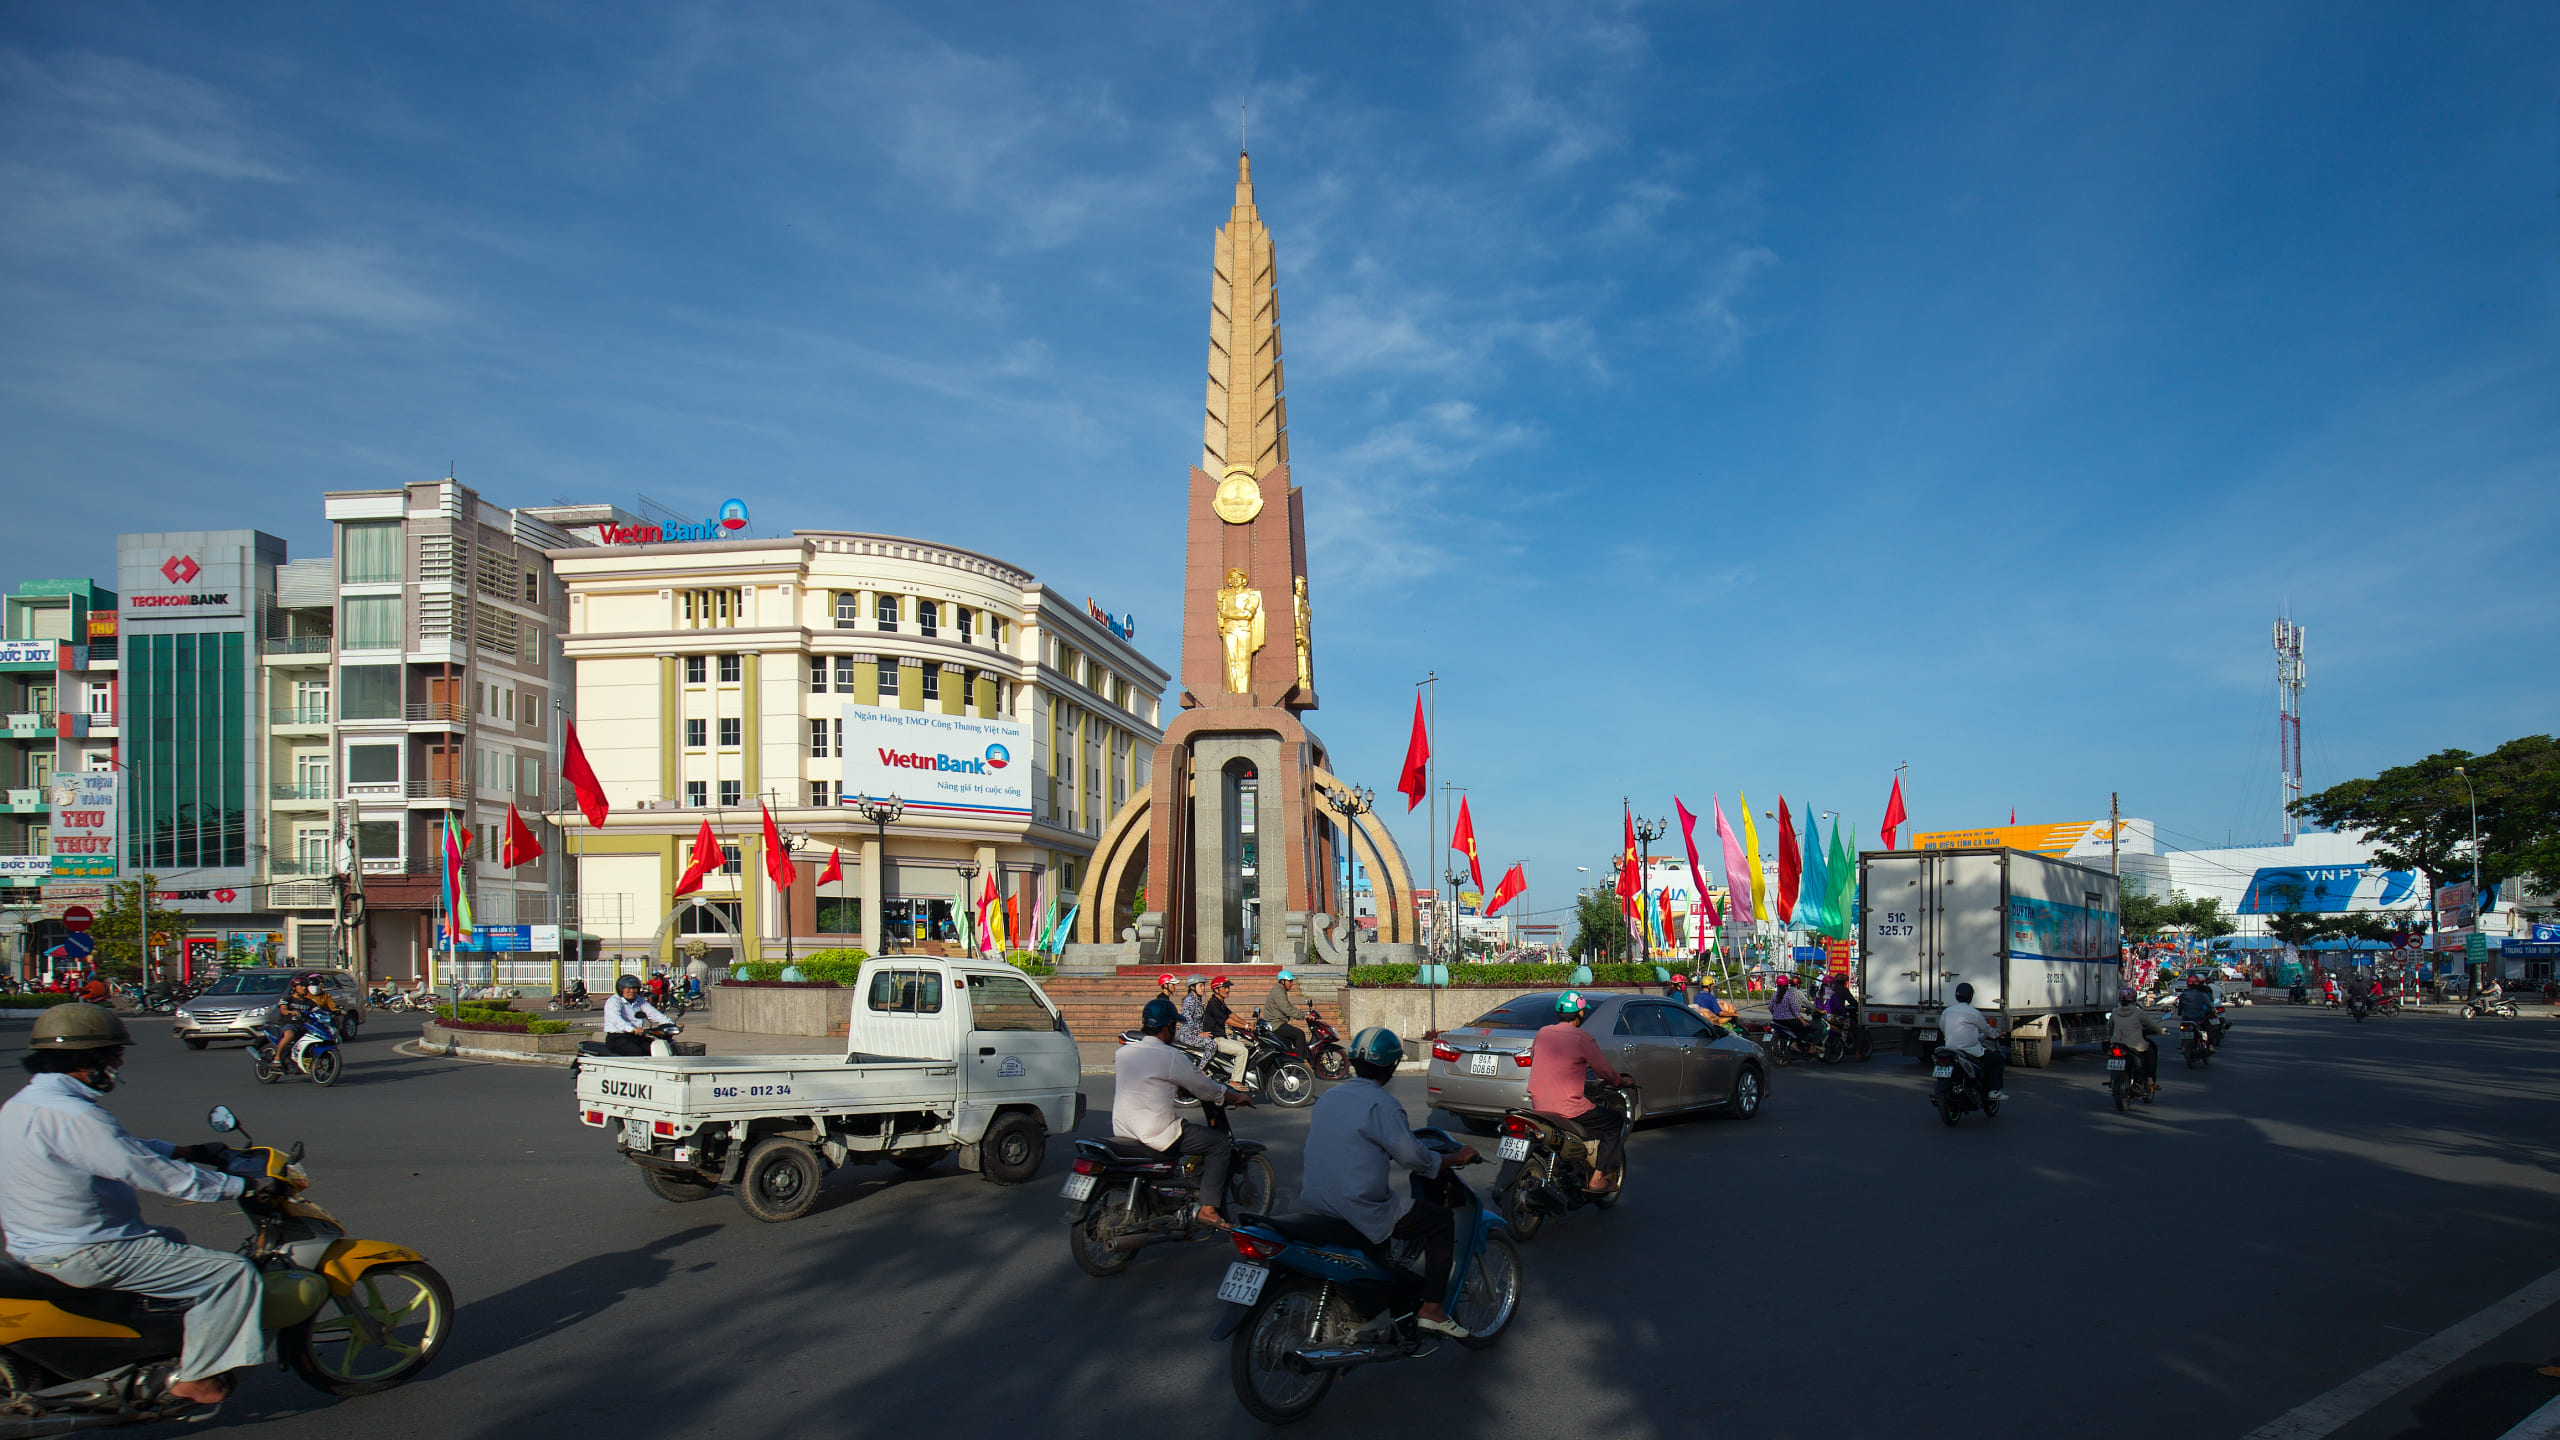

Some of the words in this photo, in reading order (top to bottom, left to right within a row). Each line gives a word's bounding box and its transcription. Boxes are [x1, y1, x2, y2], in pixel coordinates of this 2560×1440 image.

[597, 518, 720, 544] VietinBank
[130, 593, 229, 607] TECHCOMBANK
[89, 622, 115, 635] THU
[25, 649, 52, 661] DUY
[854, 711, 878, 722] Ngân
[880, 712, 903, 726] Hàng
[905, 716, 930, 726] TMCP
[931, 719, 952, 731] Công
[983, 725, 1000, 735] Việt
[1001, 726, 1020, 737] Nam
[878, 747, 987, 775] VietinBank
[84, 775, 113, 790] TIỆM
[937, 781, 958, 793] Nâng
[960, 784, 972, 793] giá
[974, 785, 983, 794] trị
[985, 786, 1003, 795] cuộc
[1004, 784, 1021, 797] sống
[80, 792, 113, 805] VÀNG
[61, 811, 105, 827] THU
[54, 830, 113, 853] THỦY
[1, 859, 25, 869] ĐỨC
[2305, 868, 2366, 881] VNPT
[1887, 912, 1906, 923] 51C
[1878, 925, 1914, 936] 325.17
[601, 1079, 652, 1100] SUZUKI
[713, 1087, 738, 1098] 94C
[1232, 1266, 1261, 1285] 69-B1
[1220, 1281, 1258, 1302] 021.79
